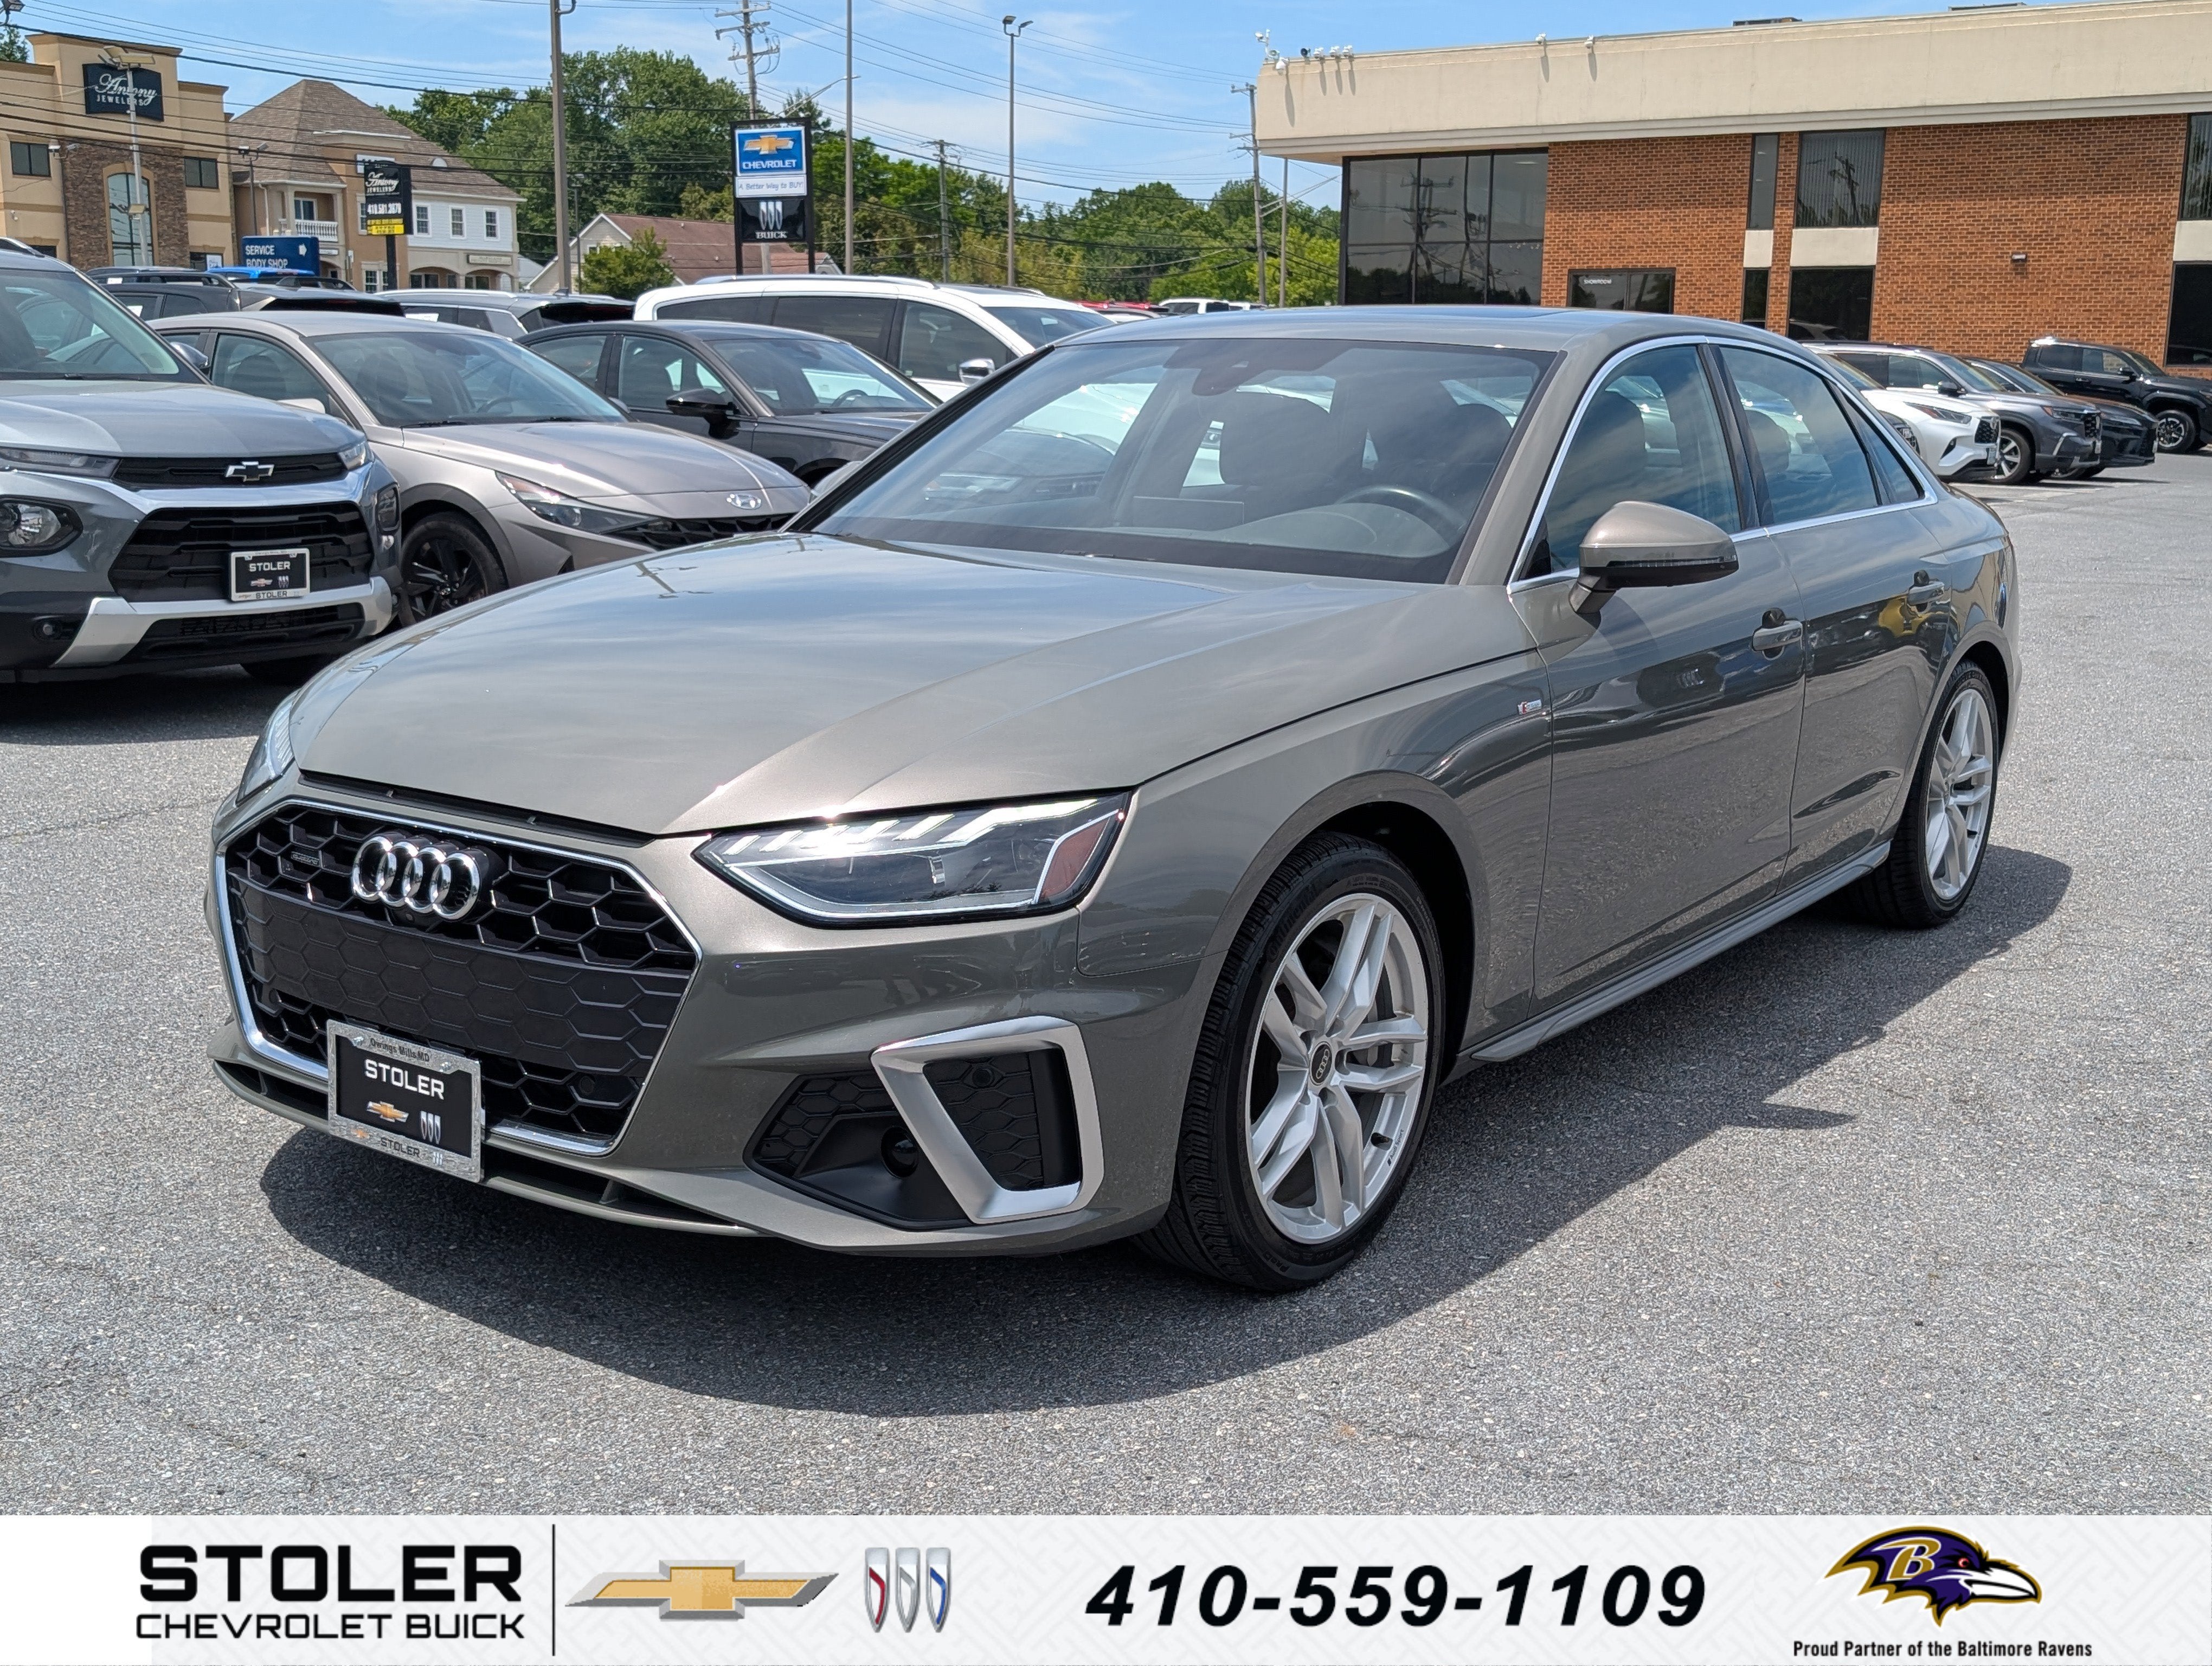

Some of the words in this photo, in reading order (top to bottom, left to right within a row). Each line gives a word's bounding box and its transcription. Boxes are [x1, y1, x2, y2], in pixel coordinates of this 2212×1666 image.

[742, 159, 796, 169] CHEVROLET
[766, 182, 779, 191] Way
[755, 231, 787, 239] BUICK
[245, 245, 275, 255] SERVICE
[246, 259, 266, 267] BODY
[268, 259, 288, 268] SHOP
[249, 561, 291, 572] STOLER
[364, 1059, 444, 1100] STOLER
[380, 1137, 420, 1158] STOLER
